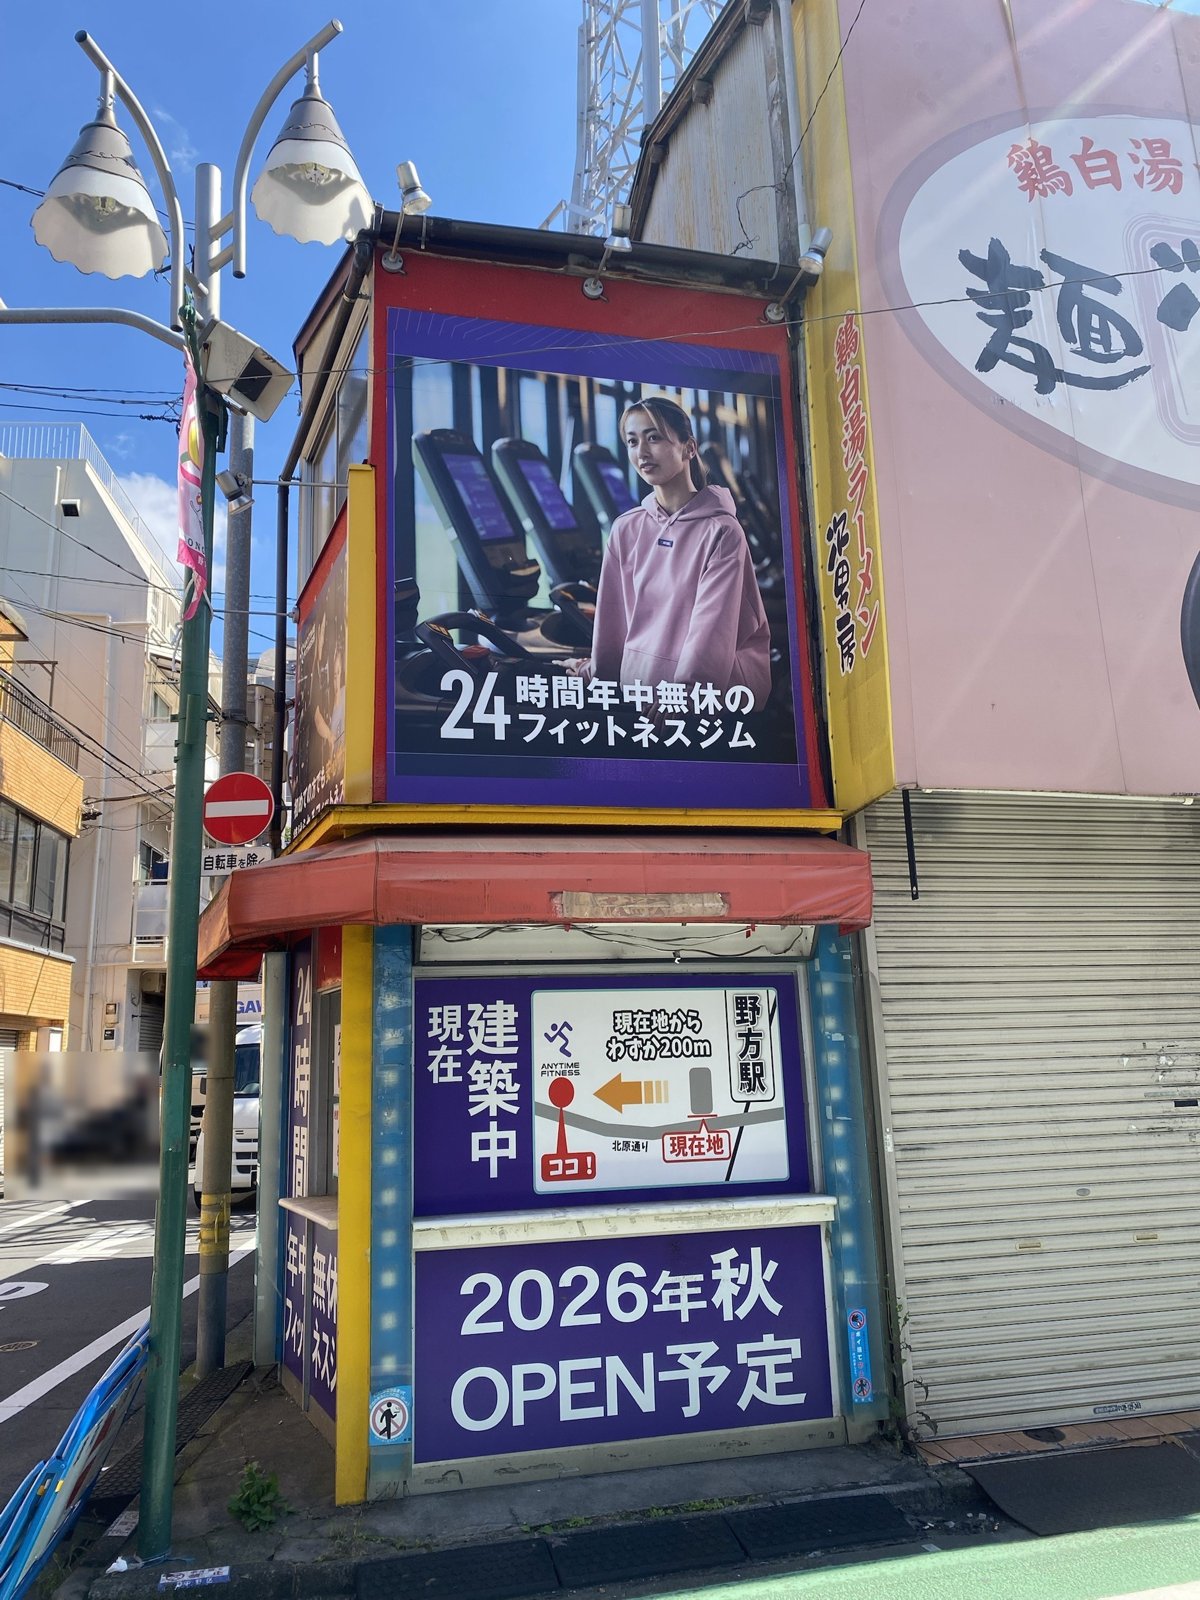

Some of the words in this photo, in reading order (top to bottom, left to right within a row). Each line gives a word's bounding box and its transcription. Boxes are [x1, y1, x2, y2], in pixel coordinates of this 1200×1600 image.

[440, 669, 511, 741] 24
[516, 674, 755, 716] 時間年中無休の
[517, 712, 757, 749] フィットネスジム
[427, 1005, 464, 1084] 現在
[606, 1036, 712, 1062] わずか200m
[612, 1008, 703, 1036] 現在地から
[734, 995, 767, 1094] 野方駅
[466, 1000, 520, 1179] 建築中
[541, 1069, 580, 1077] FITNESS
[612, 1140, 648, 1152] 北原通り
[669, 1134, 724, 1157] 現在地
[460, 1247, 783, 1335] 2026年秋
[450, 1334, 807, 1431] OPEN予定
